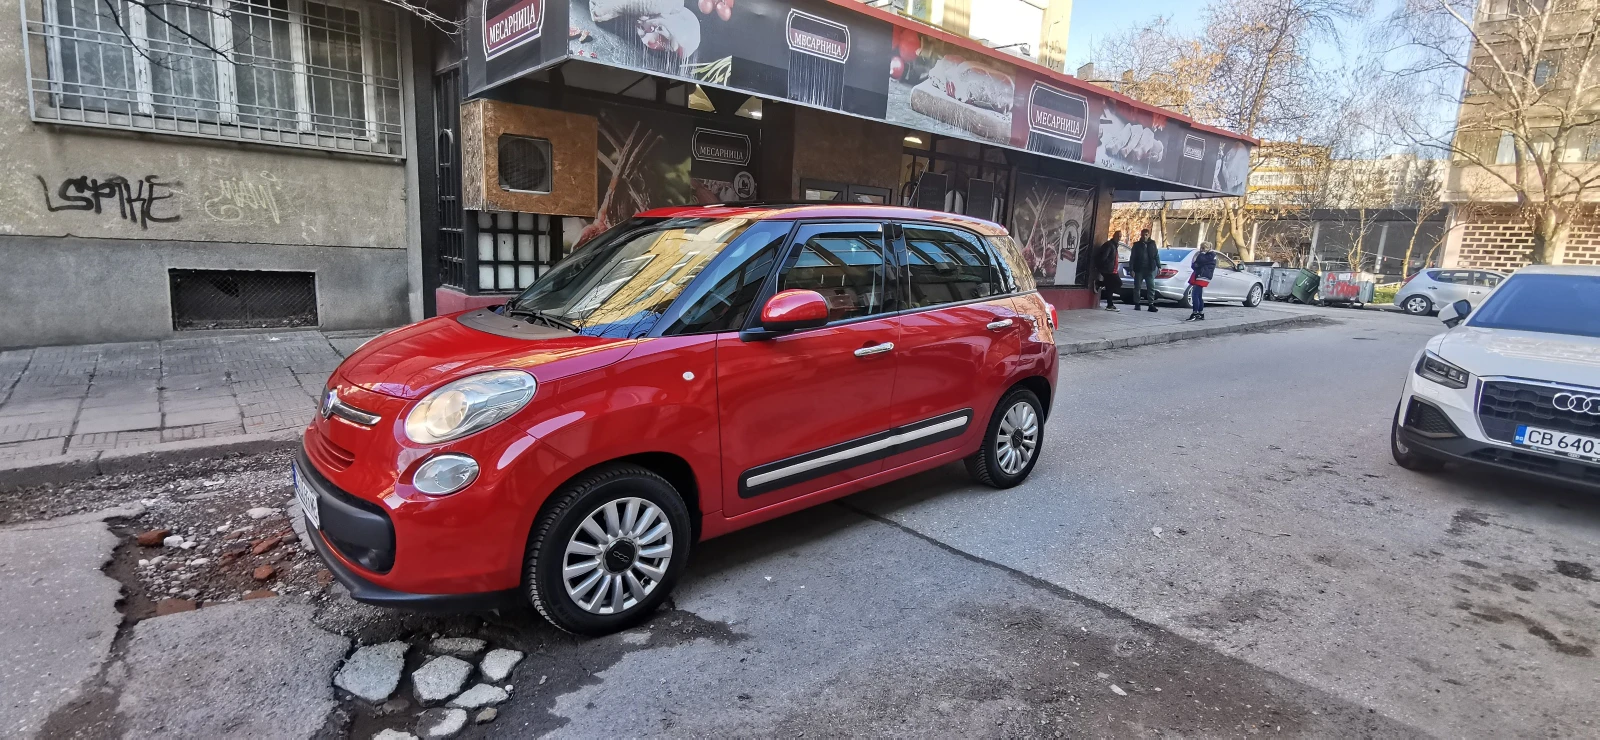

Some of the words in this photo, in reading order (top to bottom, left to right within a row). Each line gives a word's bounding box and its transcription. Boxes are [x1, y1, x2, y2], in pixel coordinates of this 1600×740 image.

[489, 3, 536, 45] МЕСАРНИЦА
[794, 32, 842, 57] МЕСАРНИЦА
[1035, 110, 1080, 135] МЕСАРНИЦА
[699, 145, 744, 160] МЕСАРНИЦА
[1528, 430, 1553, 446] CB
